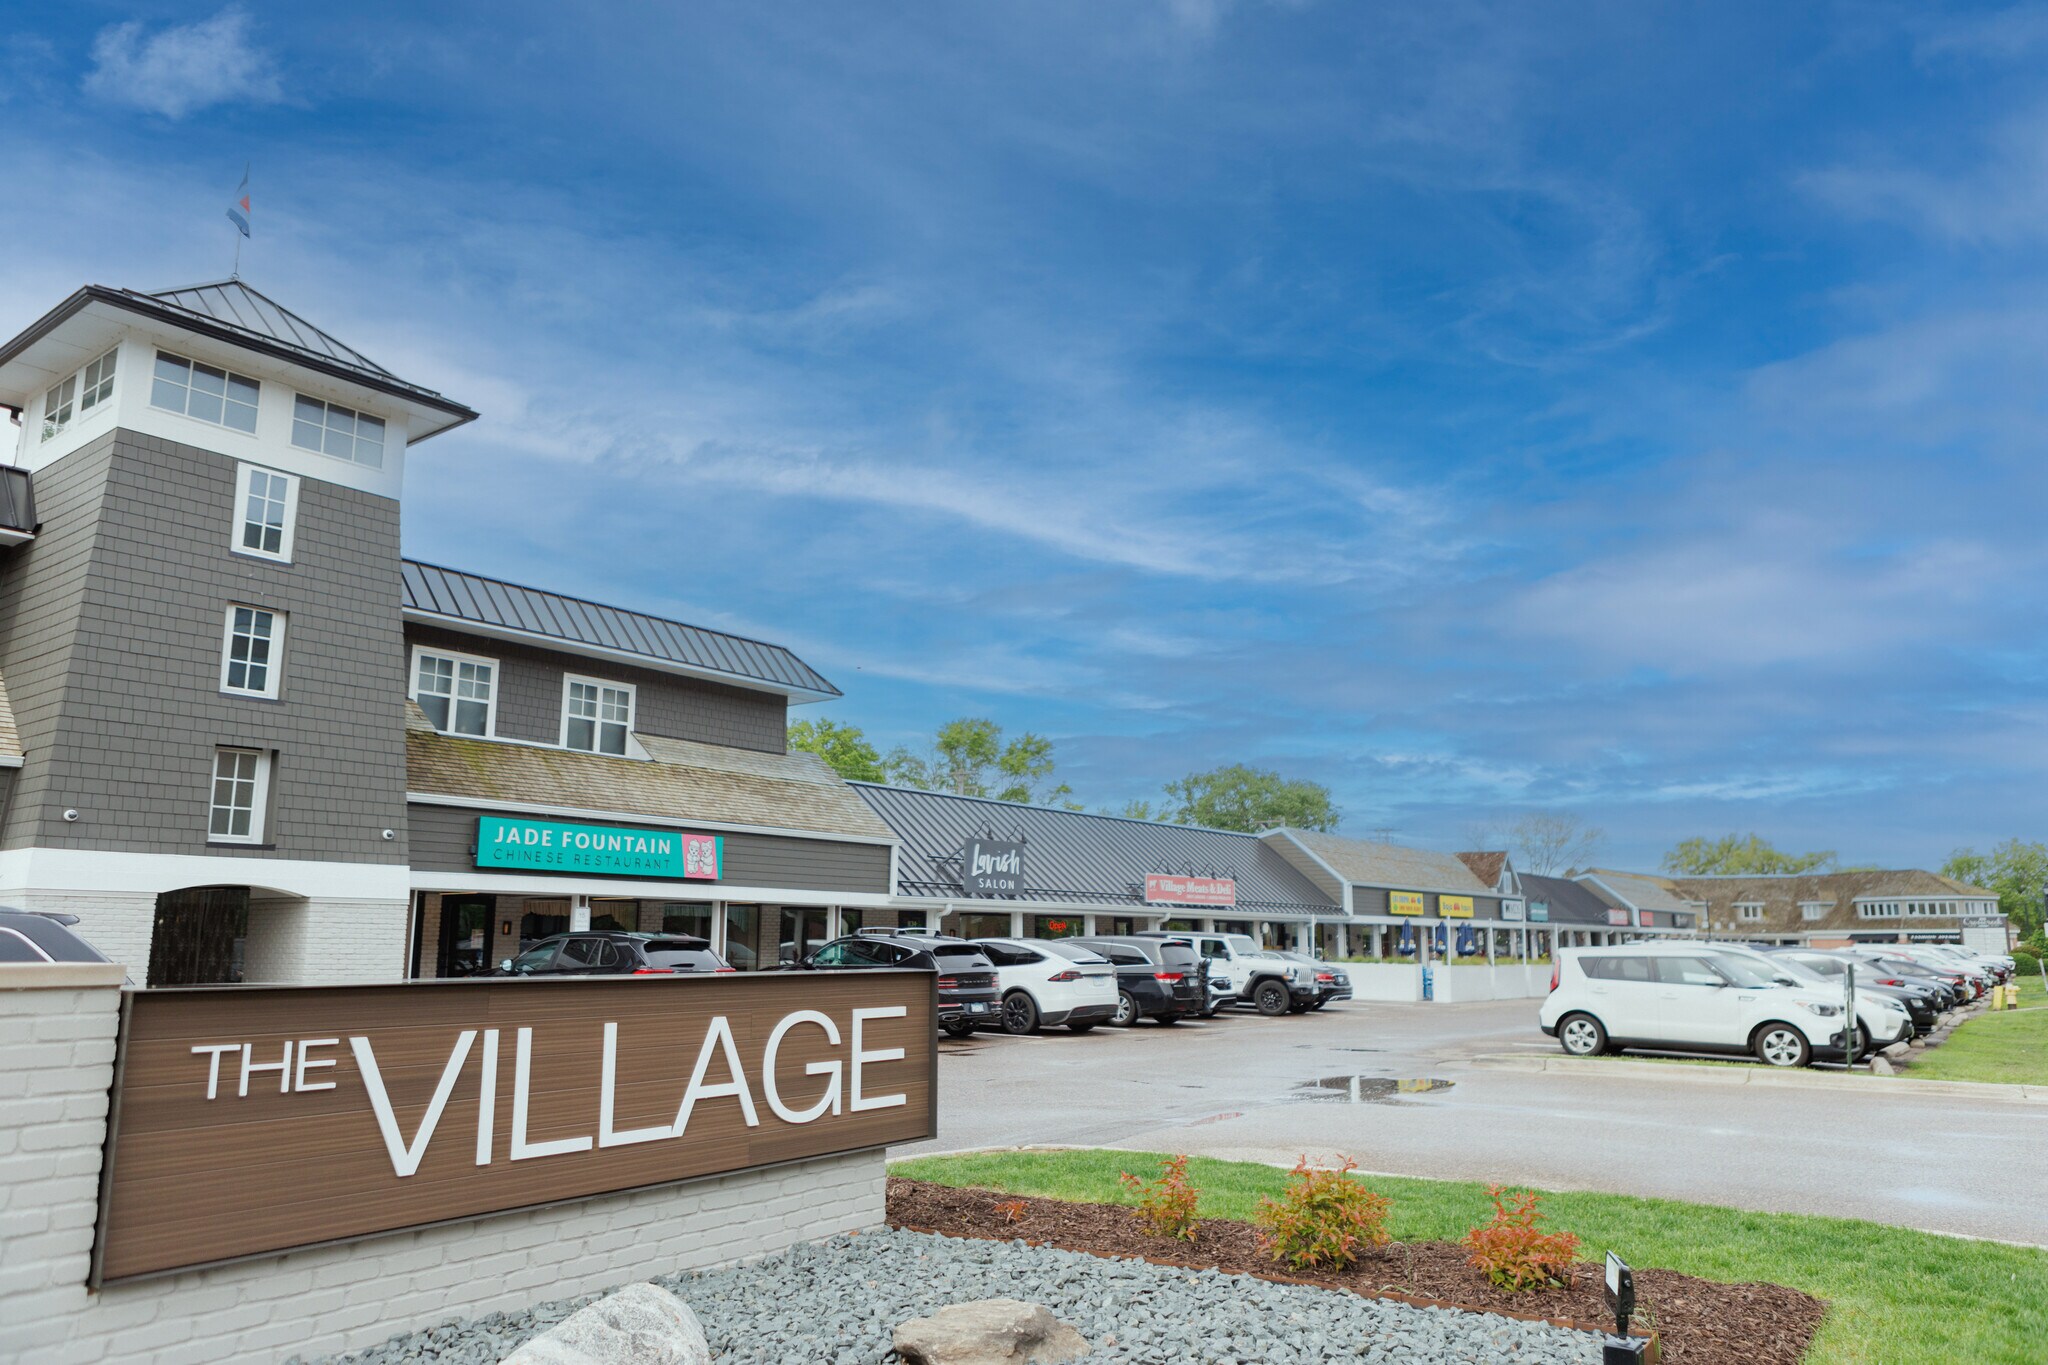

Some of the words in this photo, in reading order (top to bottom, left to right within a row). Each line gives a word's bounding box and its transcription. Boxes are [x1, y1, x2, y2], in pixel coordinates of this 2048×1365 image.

[494, 826, 553, 847] JADE
[561, 831, 671, 854] FOUNTAIN
[493, 848, 563, 864] CHINESE
[573, 853, 671, 870] RESTAURANT
[971, 843, 1020, 877] Lavish
[978, 878, 1015, 890] SALON
[1160, 880, 1185, 896] Village
[1186, 881, 1208, 893] Meats
[1209, 883, 1217, 895] &
[1217, 883, 1232, 895] Deli
[191, 1038, 339, 1100] THE
[349, 1006, 907, 1177] VILLAGE
